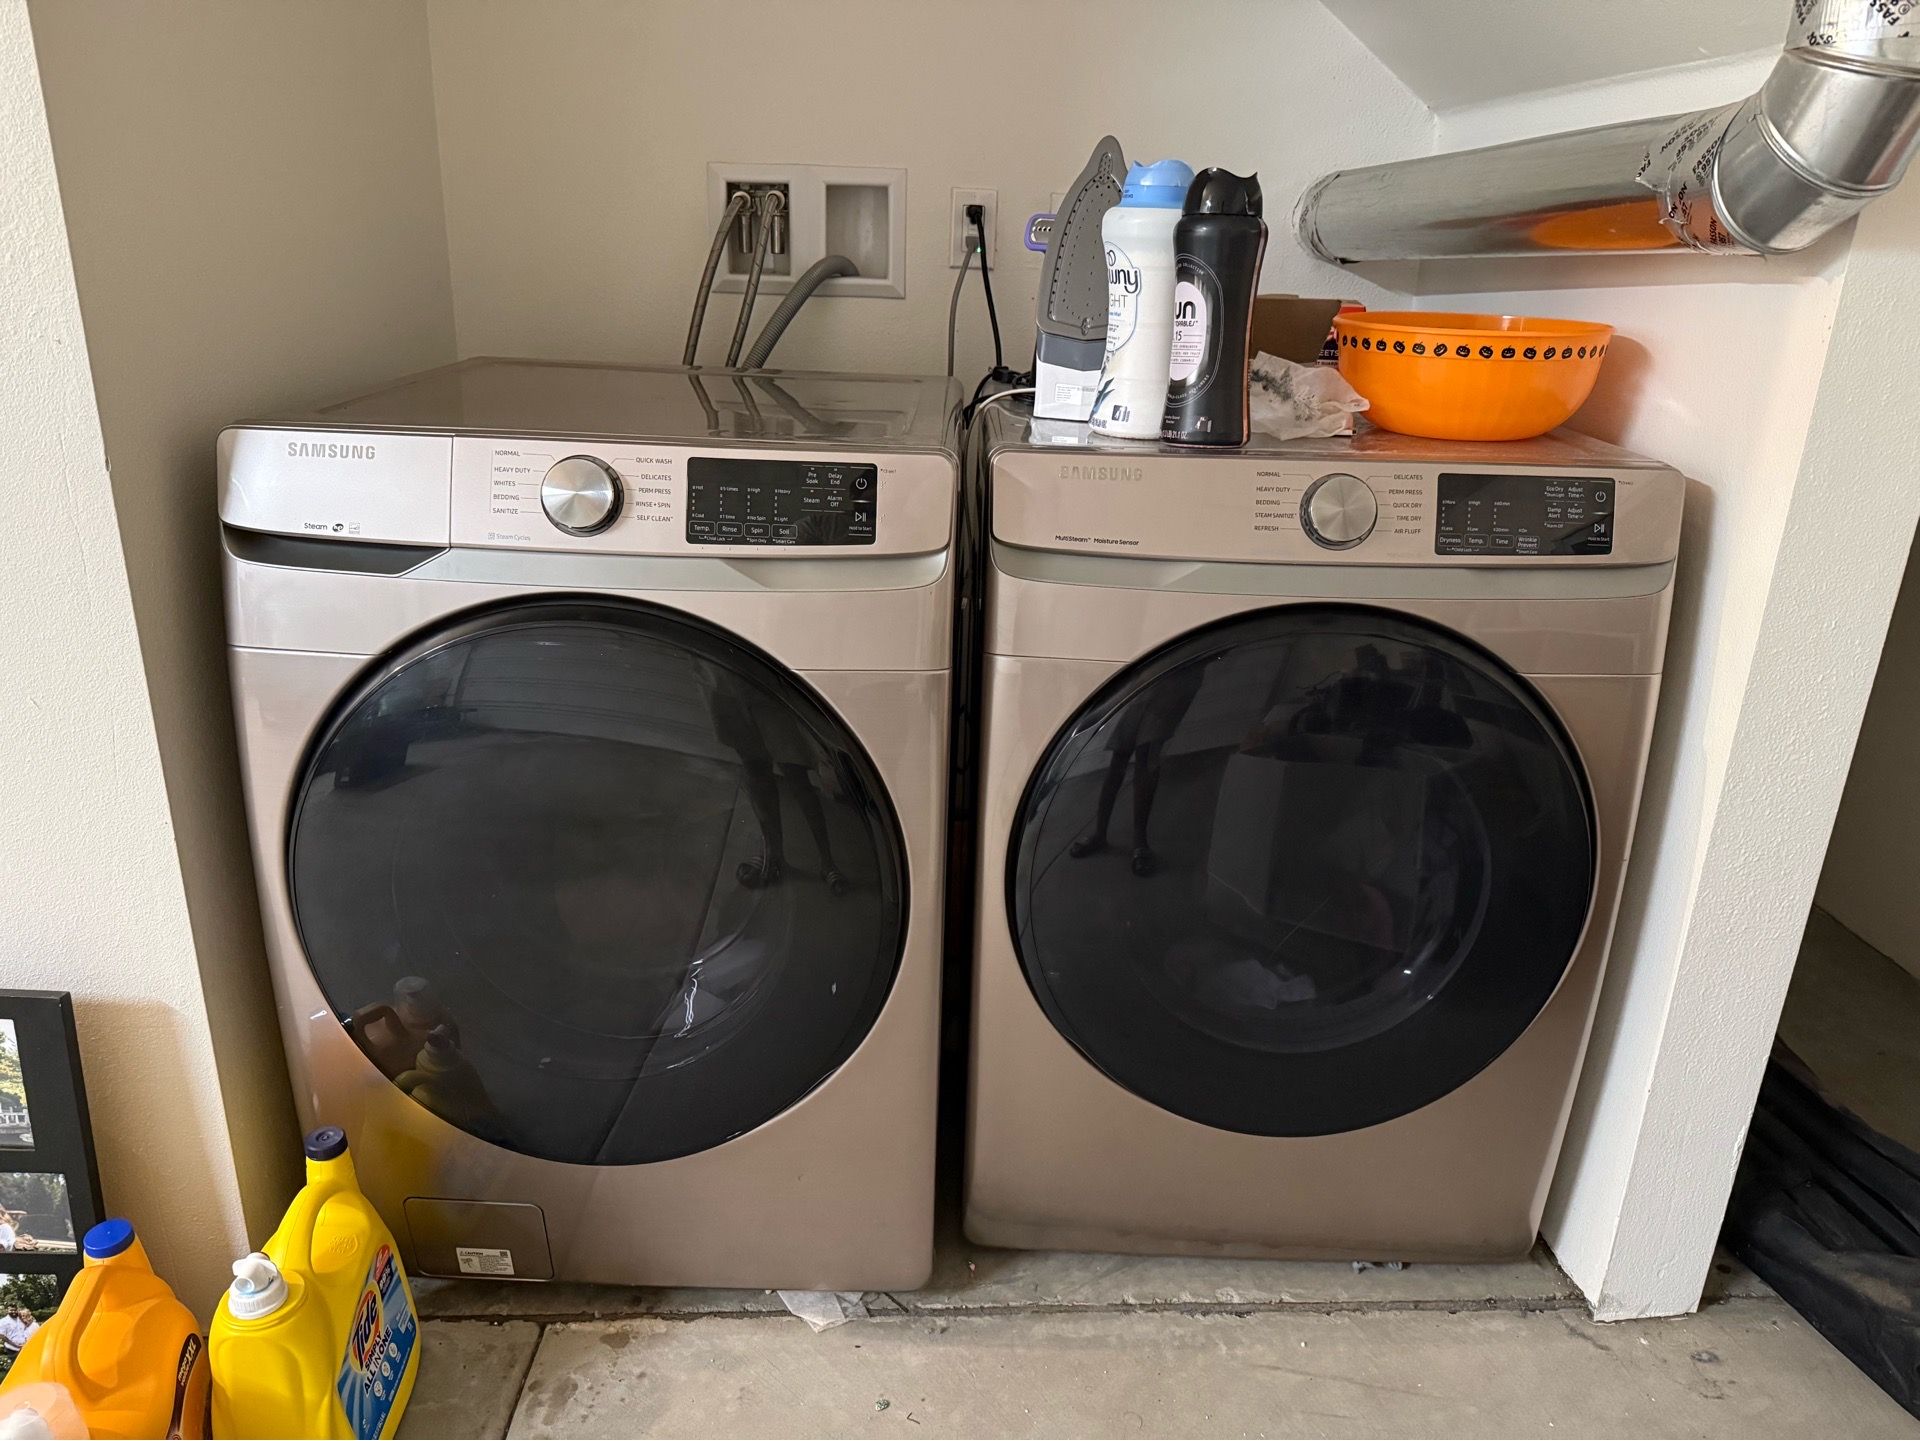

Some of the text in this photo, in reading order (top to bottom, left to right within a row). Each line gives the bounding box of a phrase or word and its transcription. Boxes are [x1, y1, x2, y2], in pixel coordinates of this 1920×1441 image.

[1109, 269, 1139, 294] wny
[1110, 293, 1128, 308] GHT
[288, 442, 376, 460] SAMSUNG
[1058, 466, 1142, 482] SAMSUNG
[304, 522, 328, 530] Steam
[352, 1293, 377, 1372] Tide
[364, 1370, 376, 1395] ALL
[380, 1327, 392, 1355] ONE
[365, 1330, 382, 1371] SIMPLY
